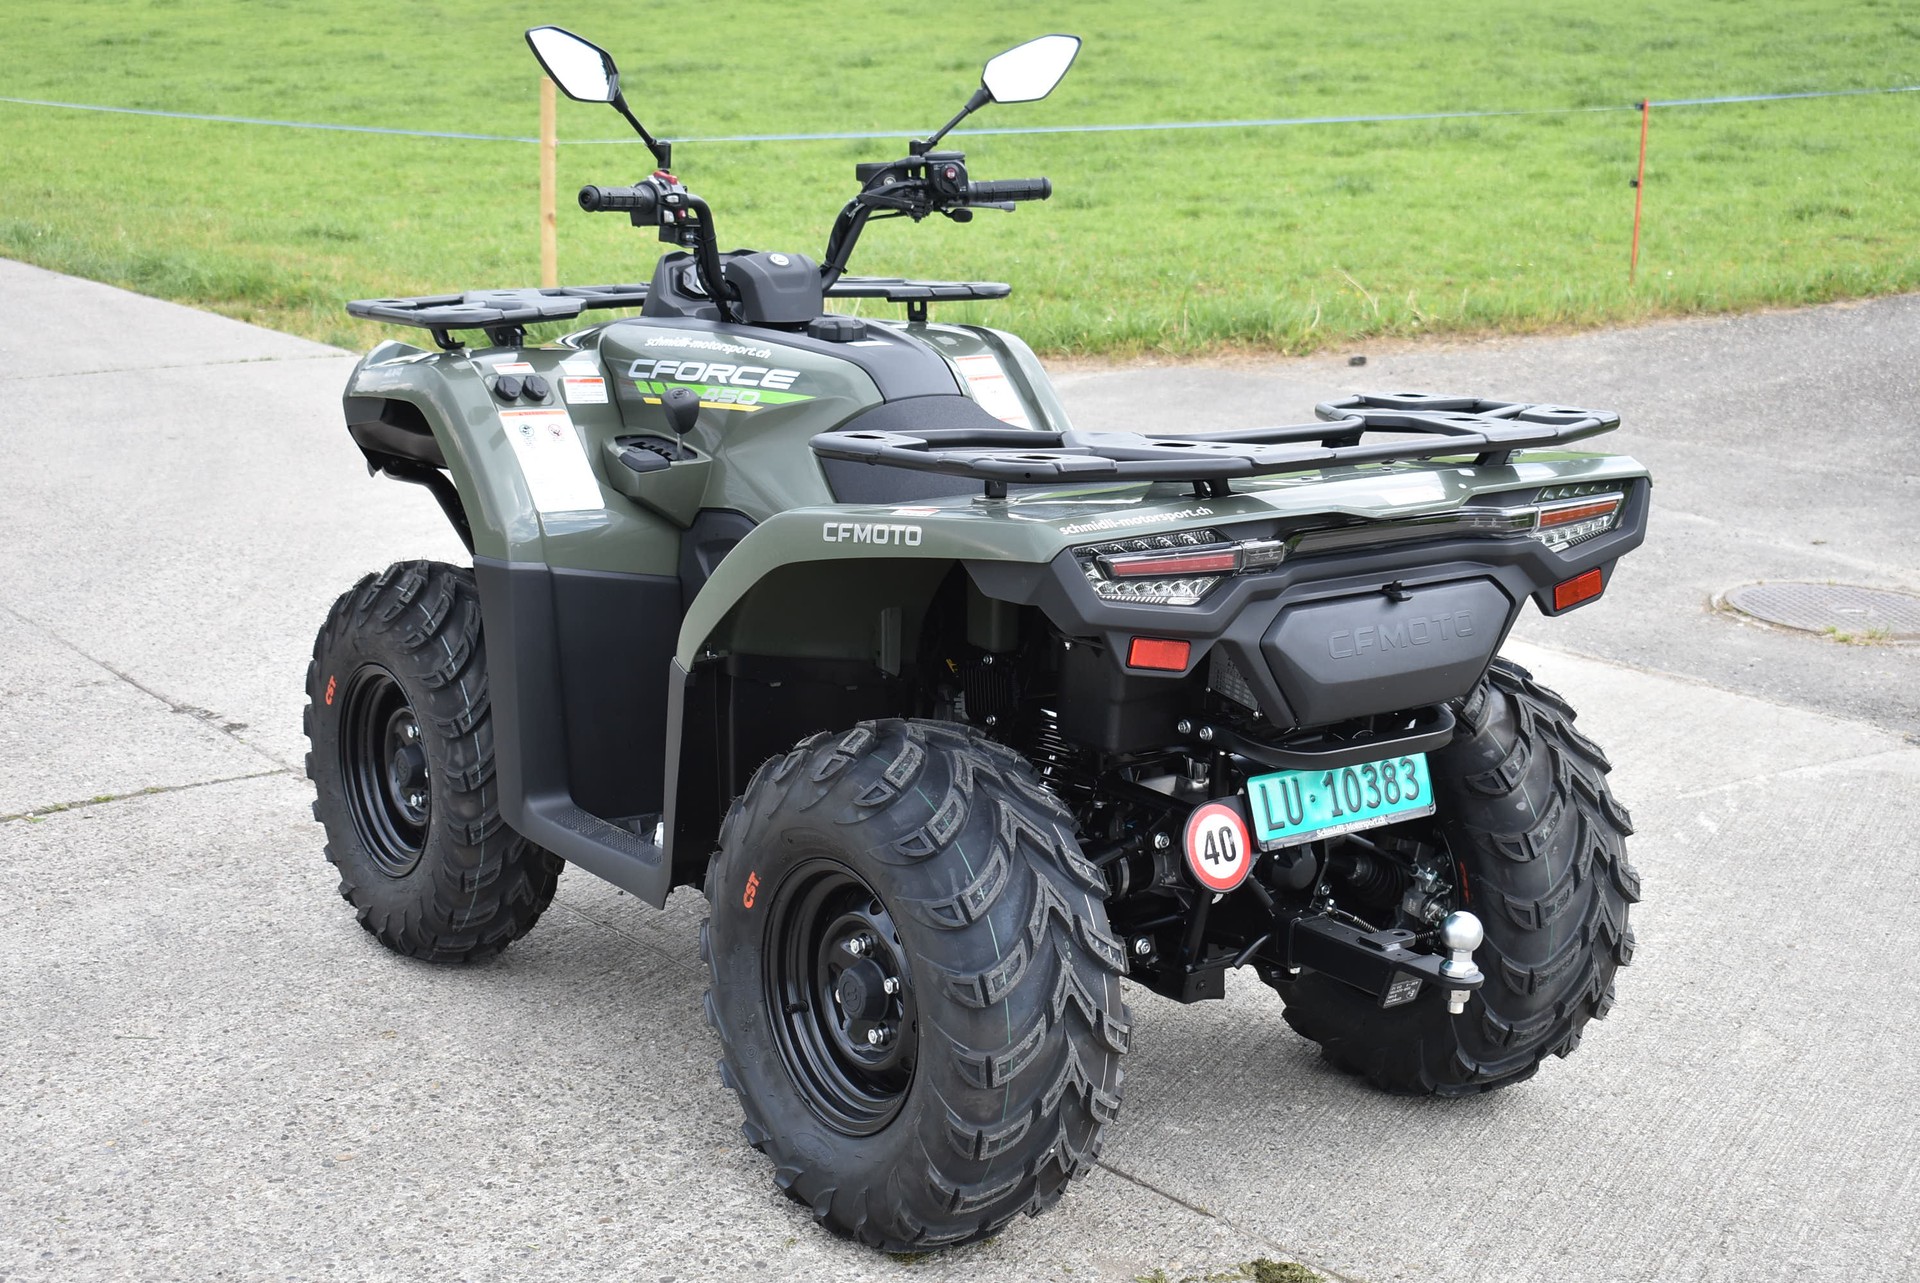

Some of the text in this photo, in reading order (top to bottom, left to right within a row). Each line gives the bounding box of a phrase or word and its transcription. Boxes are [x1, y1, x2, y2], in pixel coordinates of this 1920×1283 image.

[628, 358, 801, 390] CFORCE
[701, 387, 760, 405] 450
[822, 522, 922, 546] CFMOTO
[1059, 506, 1214, 535] schmidli-motorsport.ch
[1328, 609, 1475, 660] CFMOTO
[325, 675, 337, 705] CST
[1259, 757, 1419, 831] LU 10383
[1204, 826, 1237, 865] 40
[743, 871, 760, 908] CST
